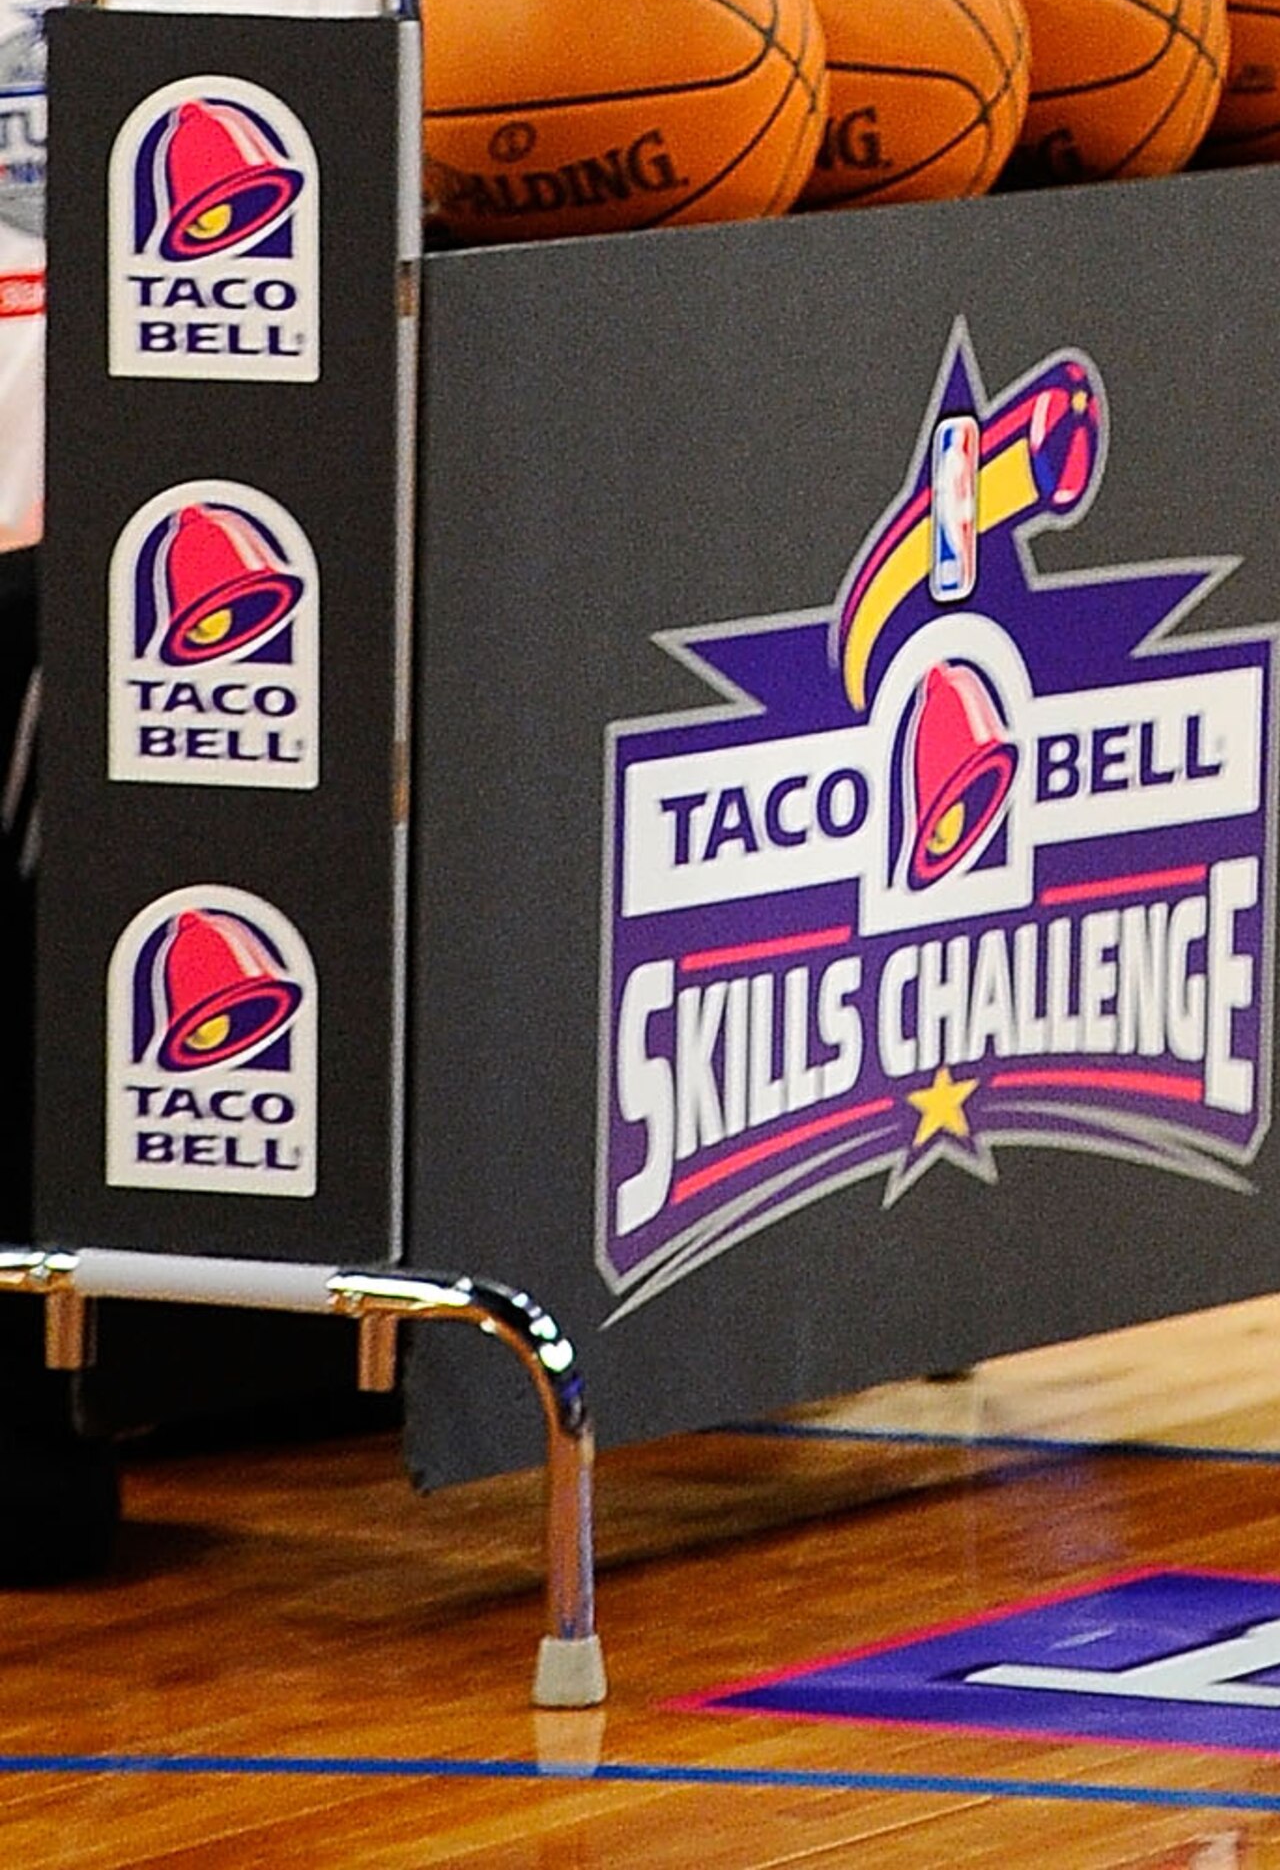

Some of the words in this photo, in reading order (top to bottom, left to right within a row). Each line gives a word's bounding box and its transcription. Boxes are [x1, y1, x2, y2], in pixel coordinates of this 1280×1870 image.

[129, 275, 297, 311] TACO
[139, 322, 301, 356] BELL
[128, 680, 297, 718] TACO
[138, 726, 301, 763] BELL
[660, 767, 871, 866] TACO
[1035, 713, 1223, 804] BELL
[615, 956, 863, 1237] SKILLS
[877, 856, 1259, 1114] CHALLENGE
[126, 1084, 295, 1124] TACO
[136, 1131, 299, 1171] BELL
